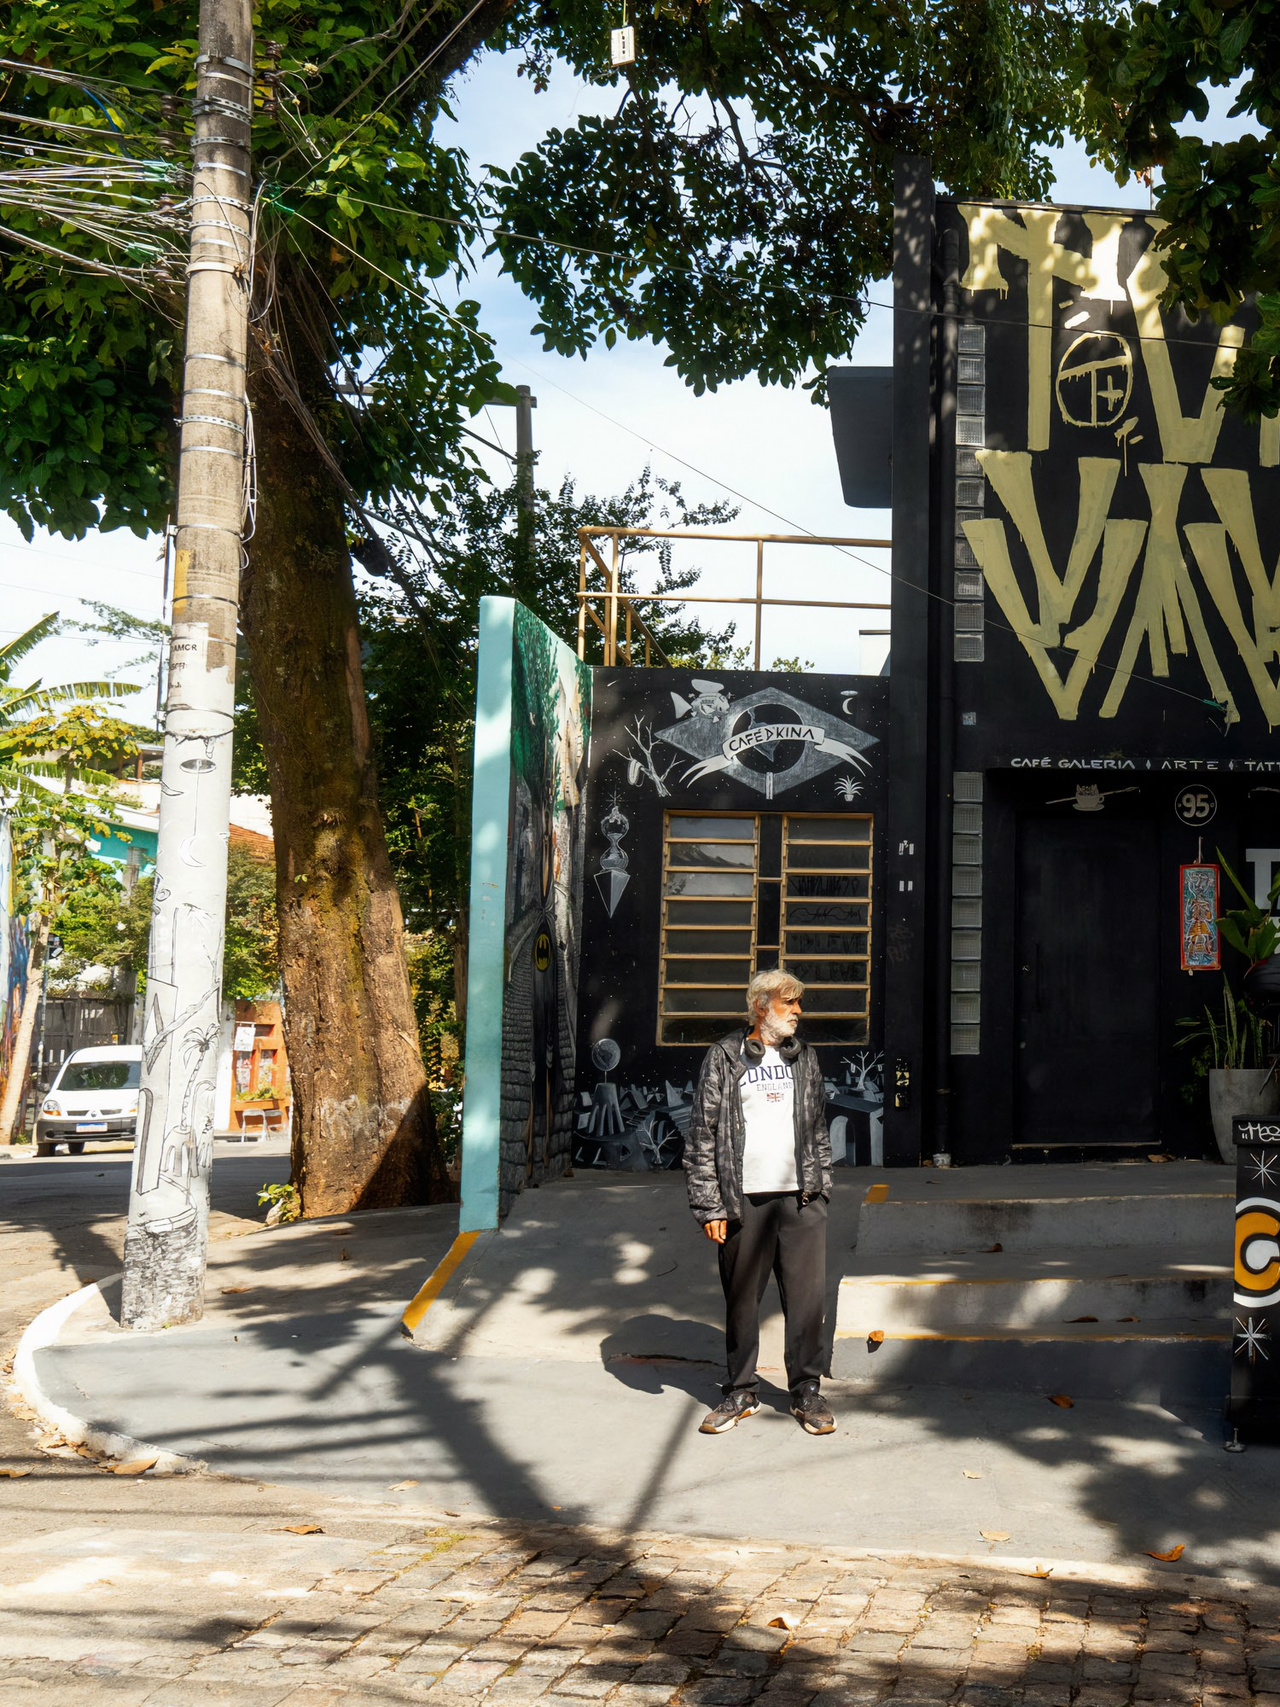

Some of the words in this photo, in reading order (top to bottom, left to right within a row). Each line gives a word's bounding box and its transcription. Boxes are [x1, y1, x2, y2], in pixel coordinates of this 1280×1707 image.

[729, 728, 763, 751] CAFÉ
[1011, 757, 1051, 768] CAFÉ
[1058, 759, 1135, 770] GALERIA
[1161, 760, 1219, 770] ARTE
[1181, 793, 1210, 818] 95
[740, 1064, 793, 1087] ONDO
[756, 1081, 792, 1092] ENGLAND
